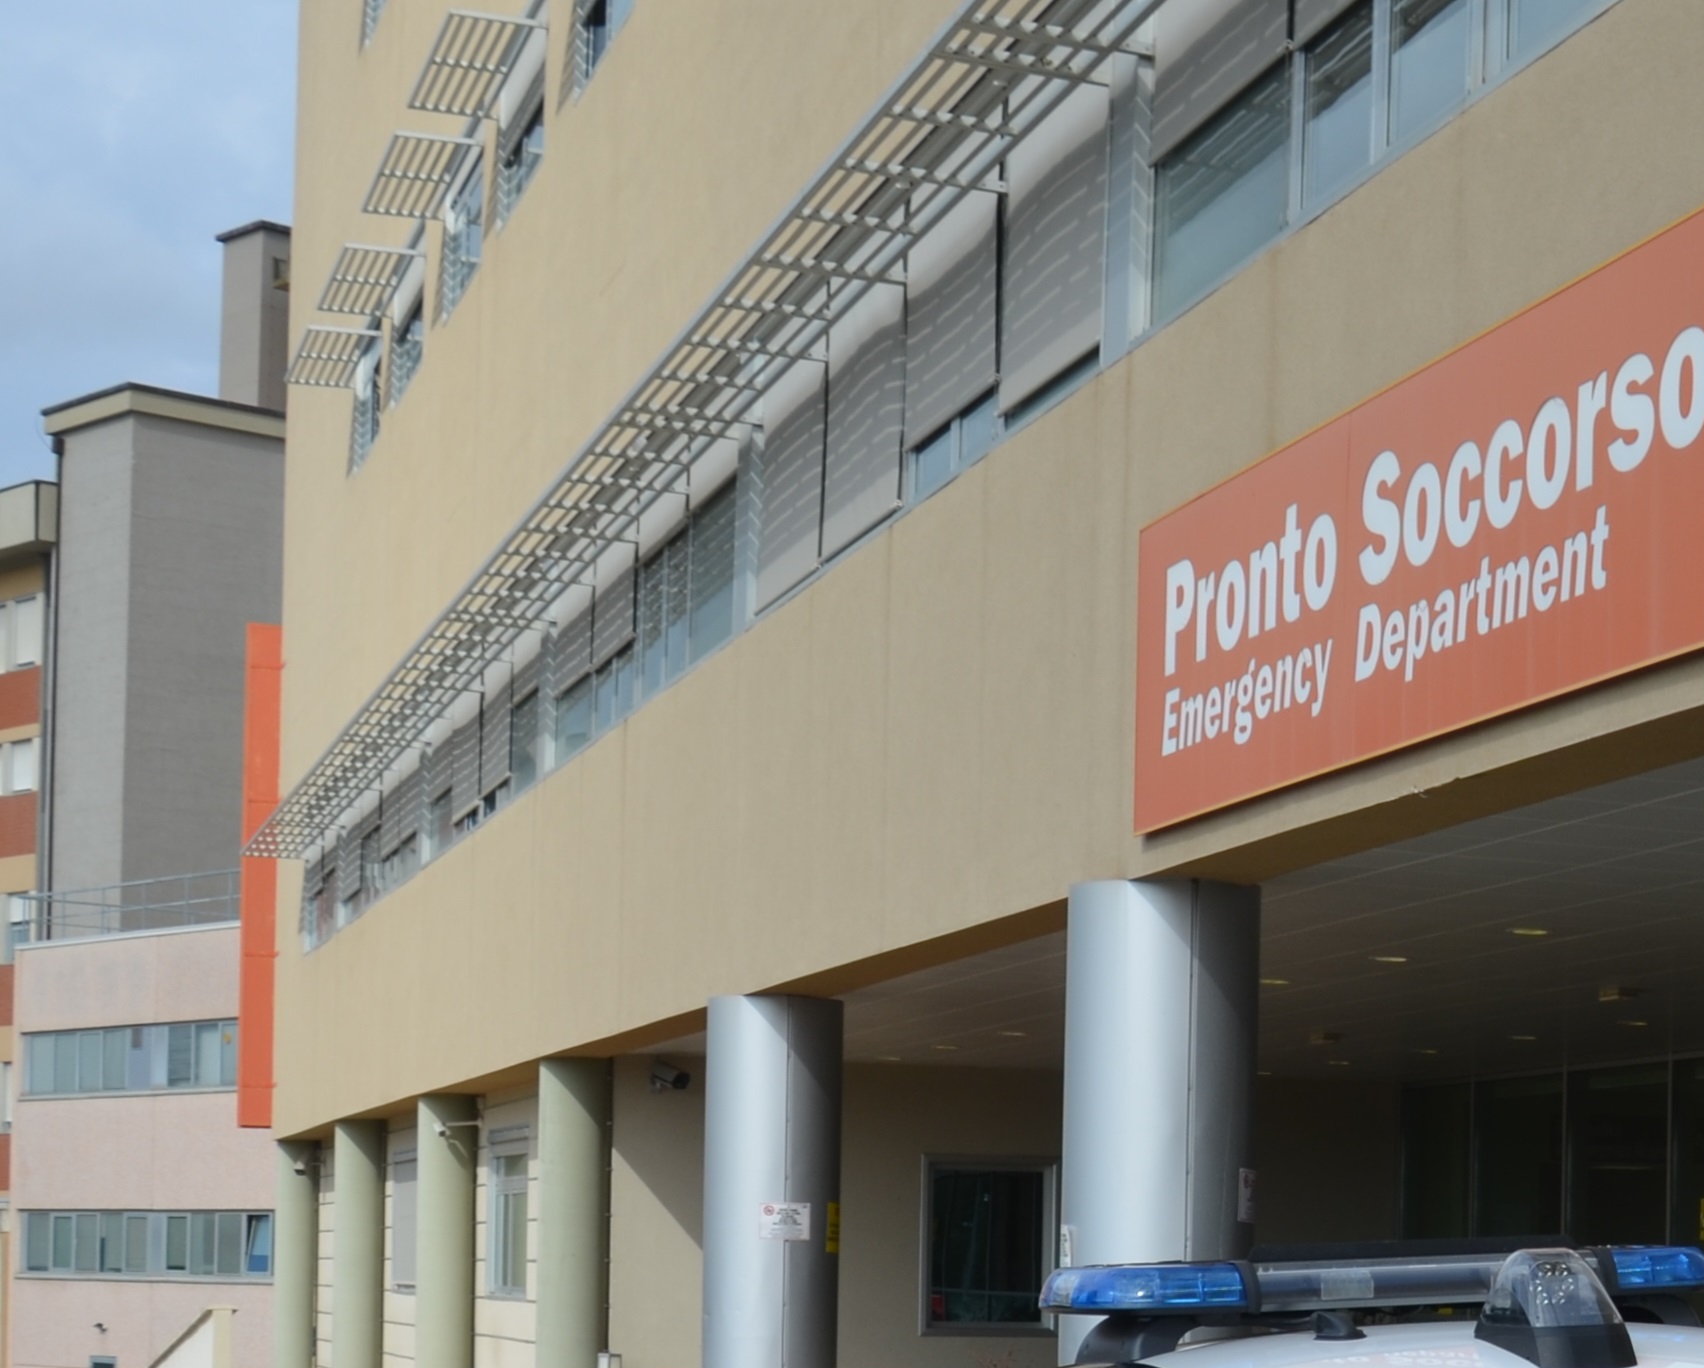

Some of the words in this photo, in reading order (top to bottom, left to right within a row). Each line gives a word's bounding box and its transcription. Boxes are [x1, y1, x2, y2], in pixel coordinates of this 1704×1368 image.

[1160, 640, 1333, 757] Emergency
[1354, 505, 1611, 682] Department
[1163, 503, 1338, 677] Pronto
